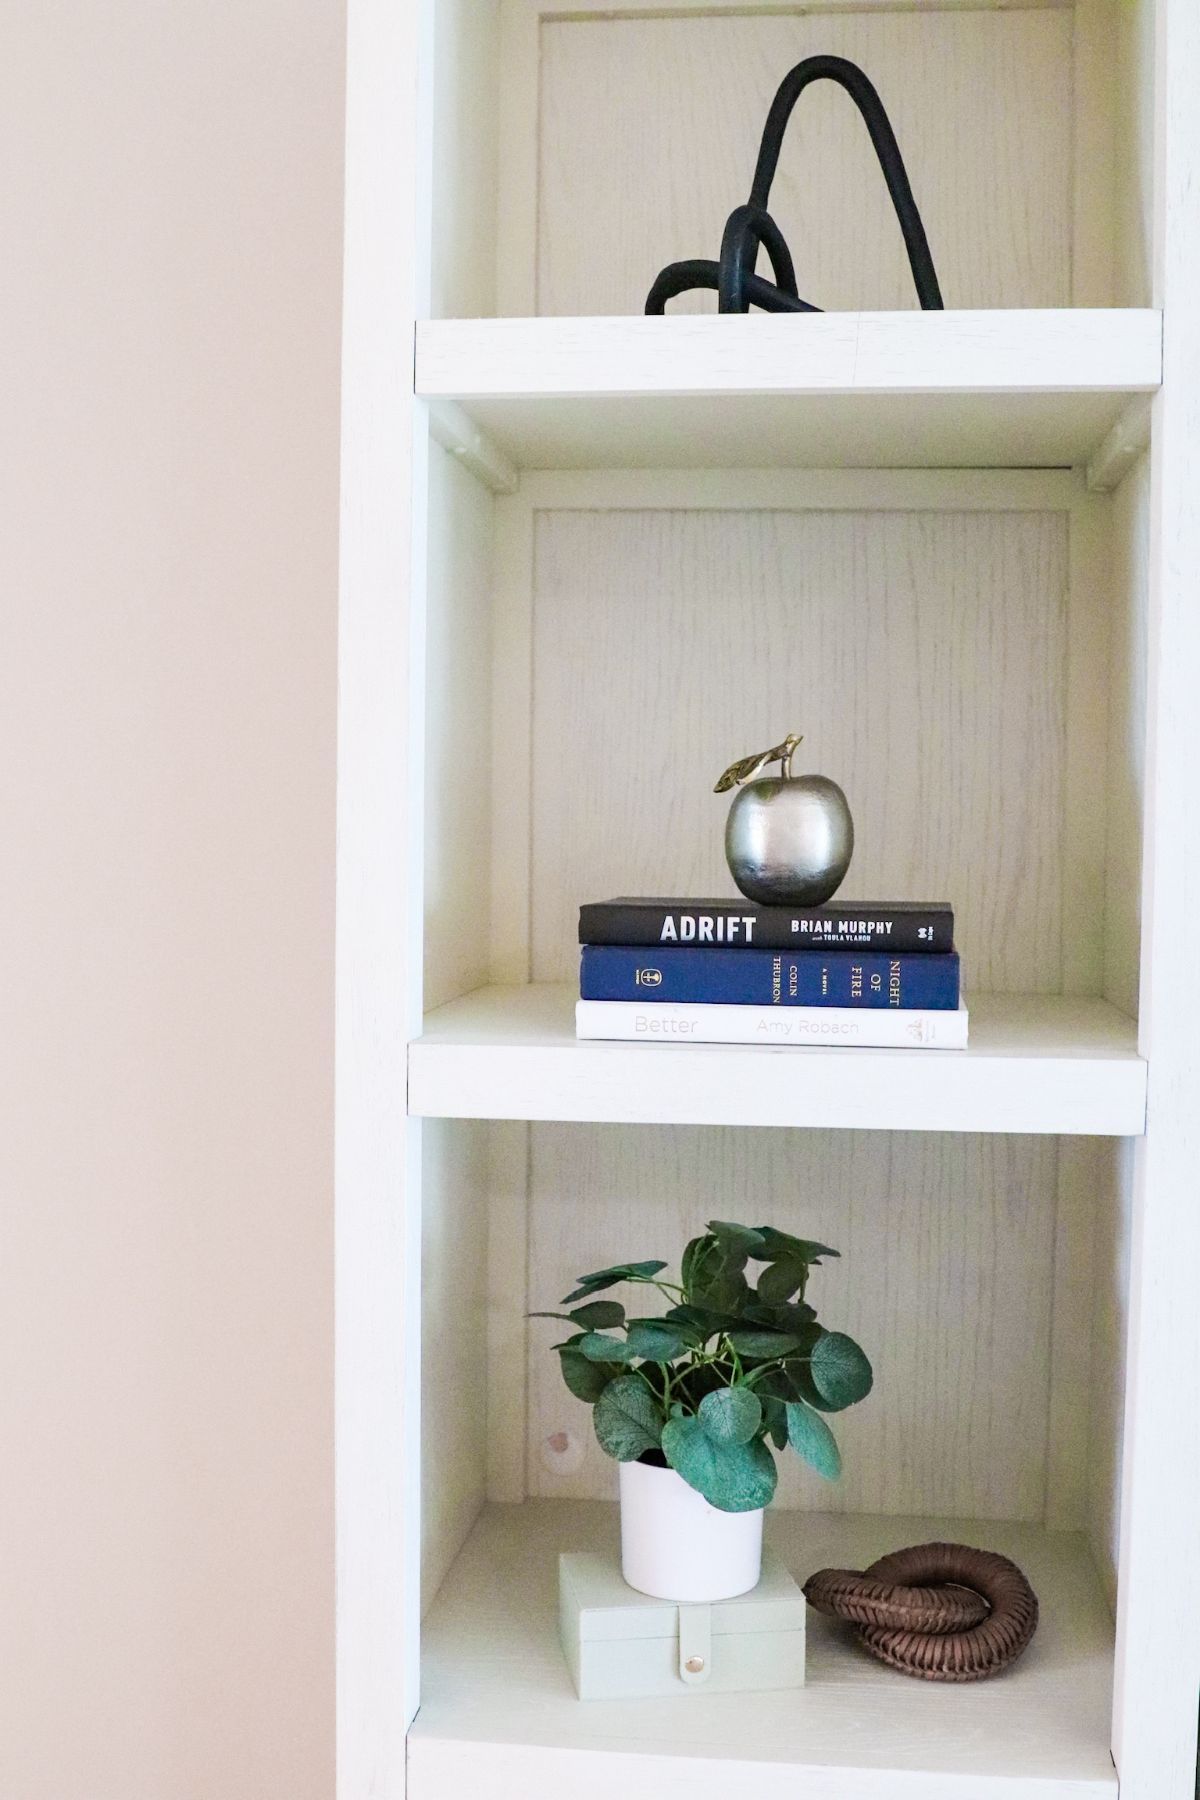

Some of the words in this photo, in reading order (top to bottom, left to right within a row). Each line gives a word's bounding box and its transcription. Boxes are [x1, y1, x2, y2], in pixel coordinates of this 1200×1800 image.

[660, 915, 757, 942] ADRIFT
[791, 920, 832, 933] BRIAN
[838, 920, 893, 934] MURPHY
[845, 934, 871, 942] VLAHOU
[772, 956, 781, 1004] THUBRON
[789, 965, 798, 996] COLIN
[852, 967, 862, 997] FIRE
[870, 973, 881, 992] OF
[890, 960, 900, 1006] NIGHT
[635, 1015, 698, 1033] Better
[756, 1019, 793, 1035] Amy
